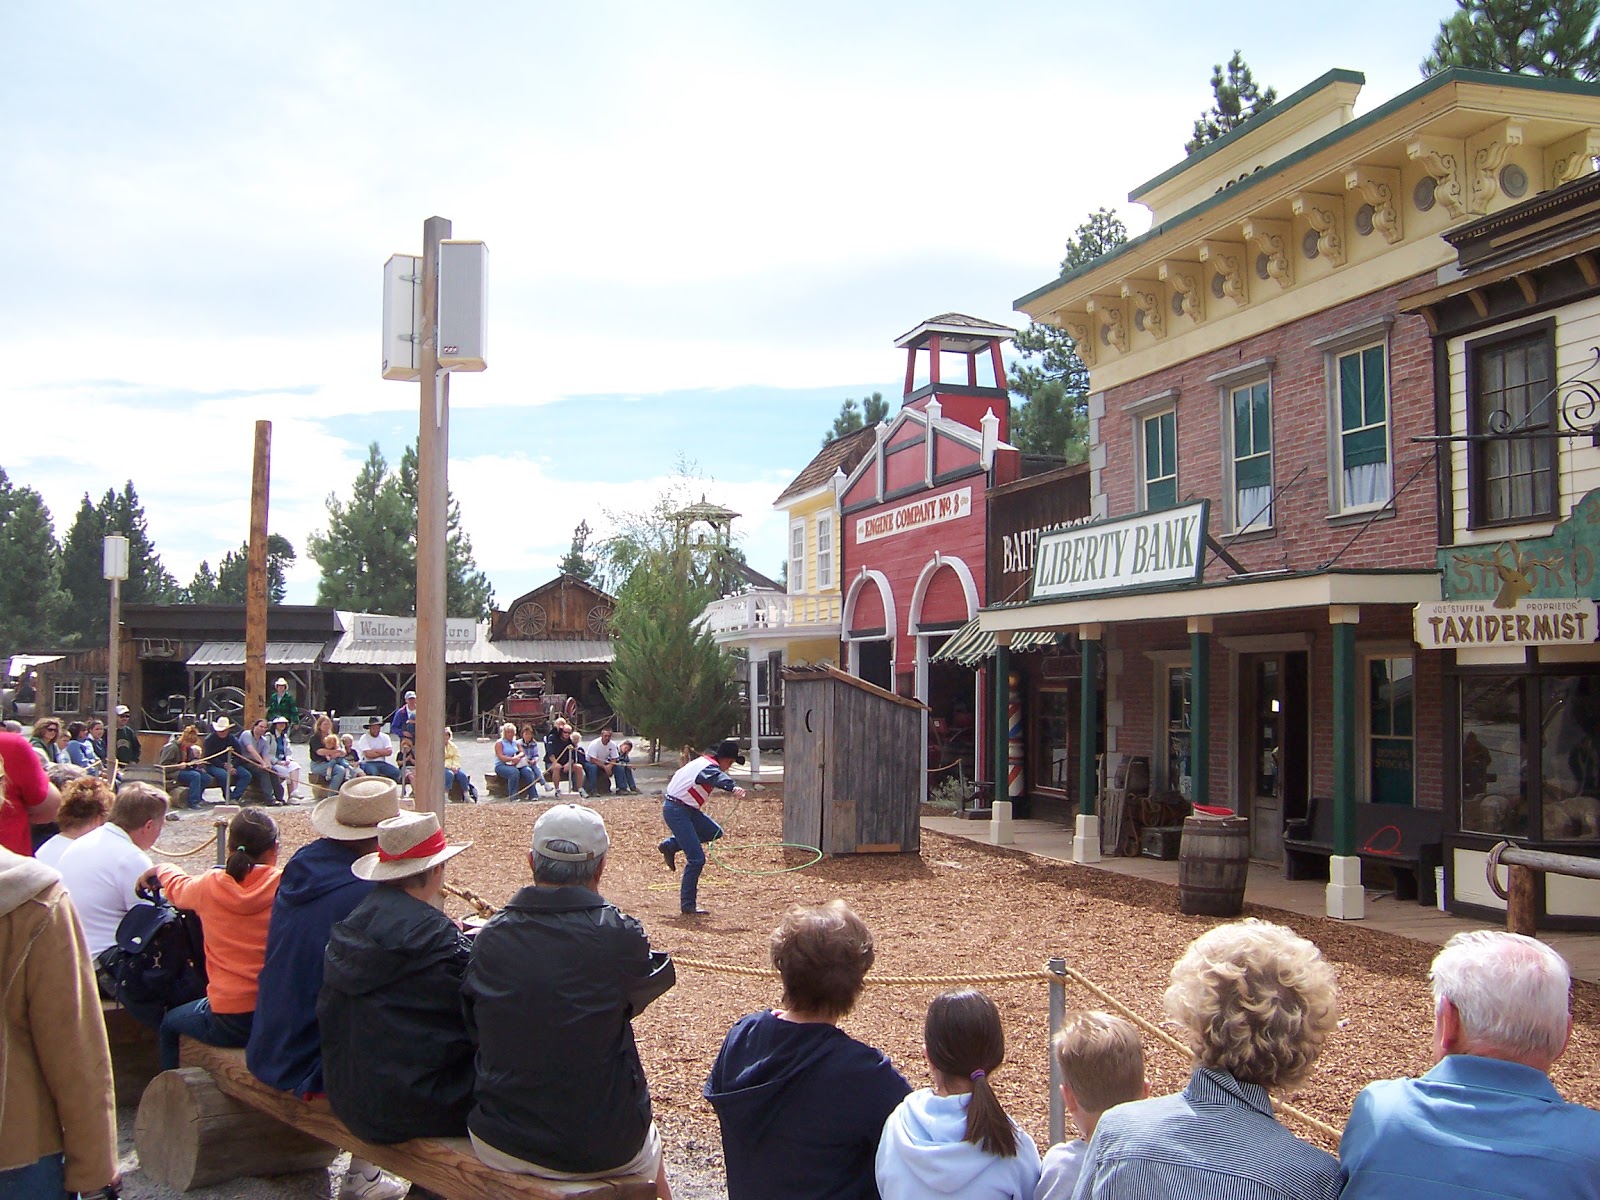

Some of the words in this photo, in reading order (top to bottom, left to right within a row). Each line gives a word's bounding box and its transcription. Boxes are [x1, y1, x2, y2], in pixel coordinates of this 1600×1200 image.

[864, 513, 894, 538] ENGINE
[896, 499, 936, 529] COMPANY
[1037, 528, 1130, 587] LIBERTY
[1131, 514, 1198, 575] BANK
[1432, 605, 1447, 614] JOE
[1526, 601, 1578, 611] PROPRIETOR
[360, 620, 403, 637] Walker
[1427, 612, 1590, 645] TAXIDERMIST
